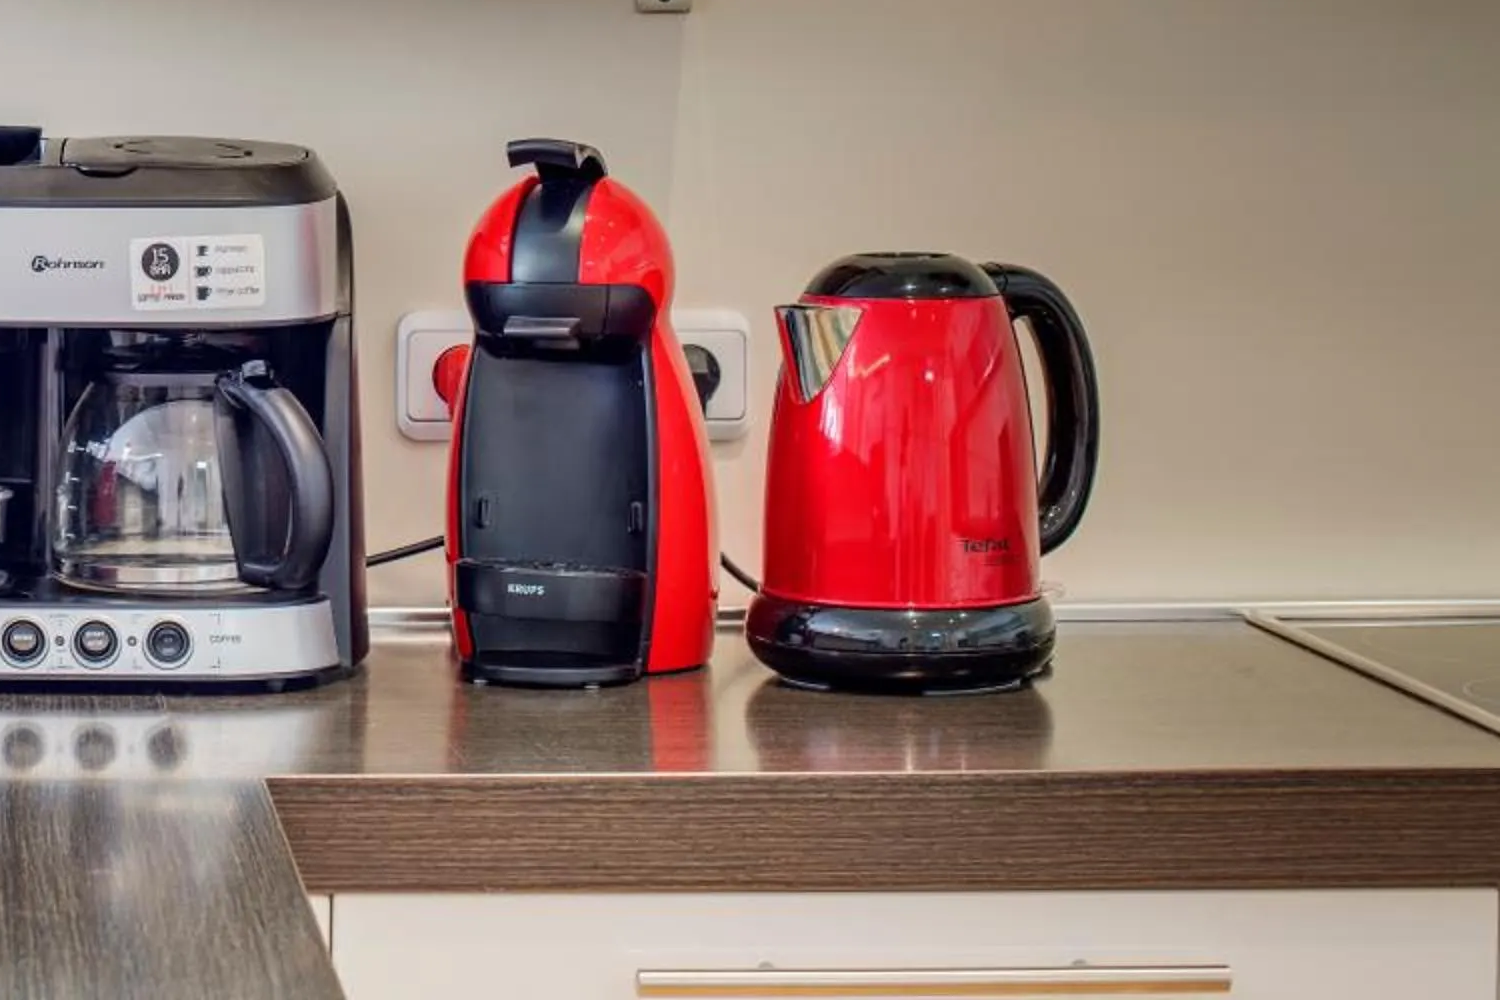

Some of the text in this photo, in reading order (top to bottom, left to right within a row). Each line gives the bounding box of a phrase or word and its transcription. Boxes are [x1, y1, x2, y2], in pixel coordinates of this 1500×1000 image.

[152, 247, 169, 263] 15
[32, 255, 105, 272] Rohnson
[507, 583, 545, 596] KRUPS
